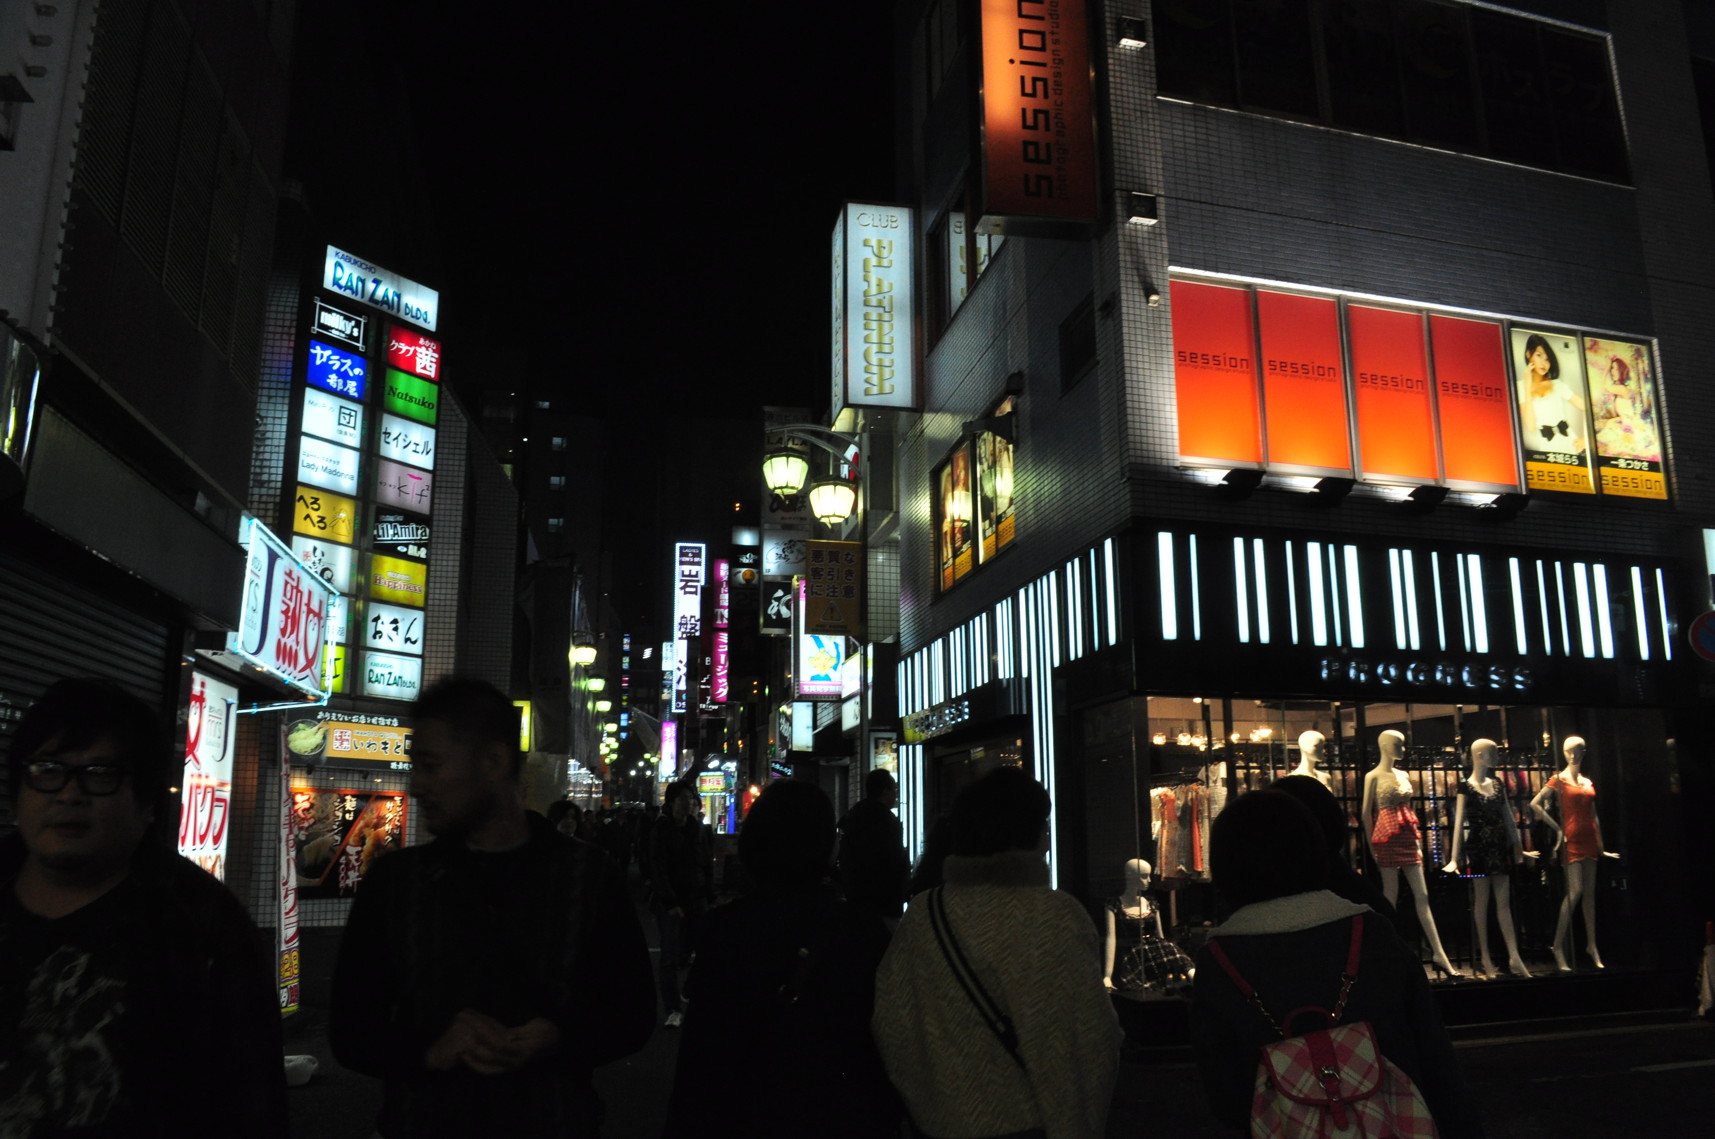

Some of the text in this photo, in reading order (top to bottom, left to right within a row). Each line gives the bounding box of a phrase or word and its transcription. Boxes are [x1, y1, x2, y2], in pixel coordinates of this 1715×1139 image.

[1010, 0, 1053, 198] session
[856, 212, 900, 230] CLUB
[863, 238, 895, 397] PLATINUM
[1177, 350, 1249, 371] session
[1268, 359, 1336, 379] session
[326, 373, 359, 398] 部屋
[1359, 372, 1424, 390] session
[1441, 381, 1503, 398] session
[387, 386, 435, 410] Natsuko
[382, 427, 432, 456] セイシェル
[301, 459, 355, 481] Lady Madonna
[1526, 468, 1592, 487] session
[1601, 474, 1663, 492] session
[810, 549, 856, 564] 悪質な
[373, 574, 423, 594] Happiness
[810, 566, 856, 581] 客引き
[241, 538, 284, 656] J
[810, 584, 856, 599] に注意
[275, 568, 324, 686] 熟女
[714, 632, 728, 699] ミュージック
[353, 738, 402, 755] いわもと
[344, 794, 357, 821] 麺は
[332, 797, 344, 847] シコシコ
[384, 801, 394, 848] サクサク
